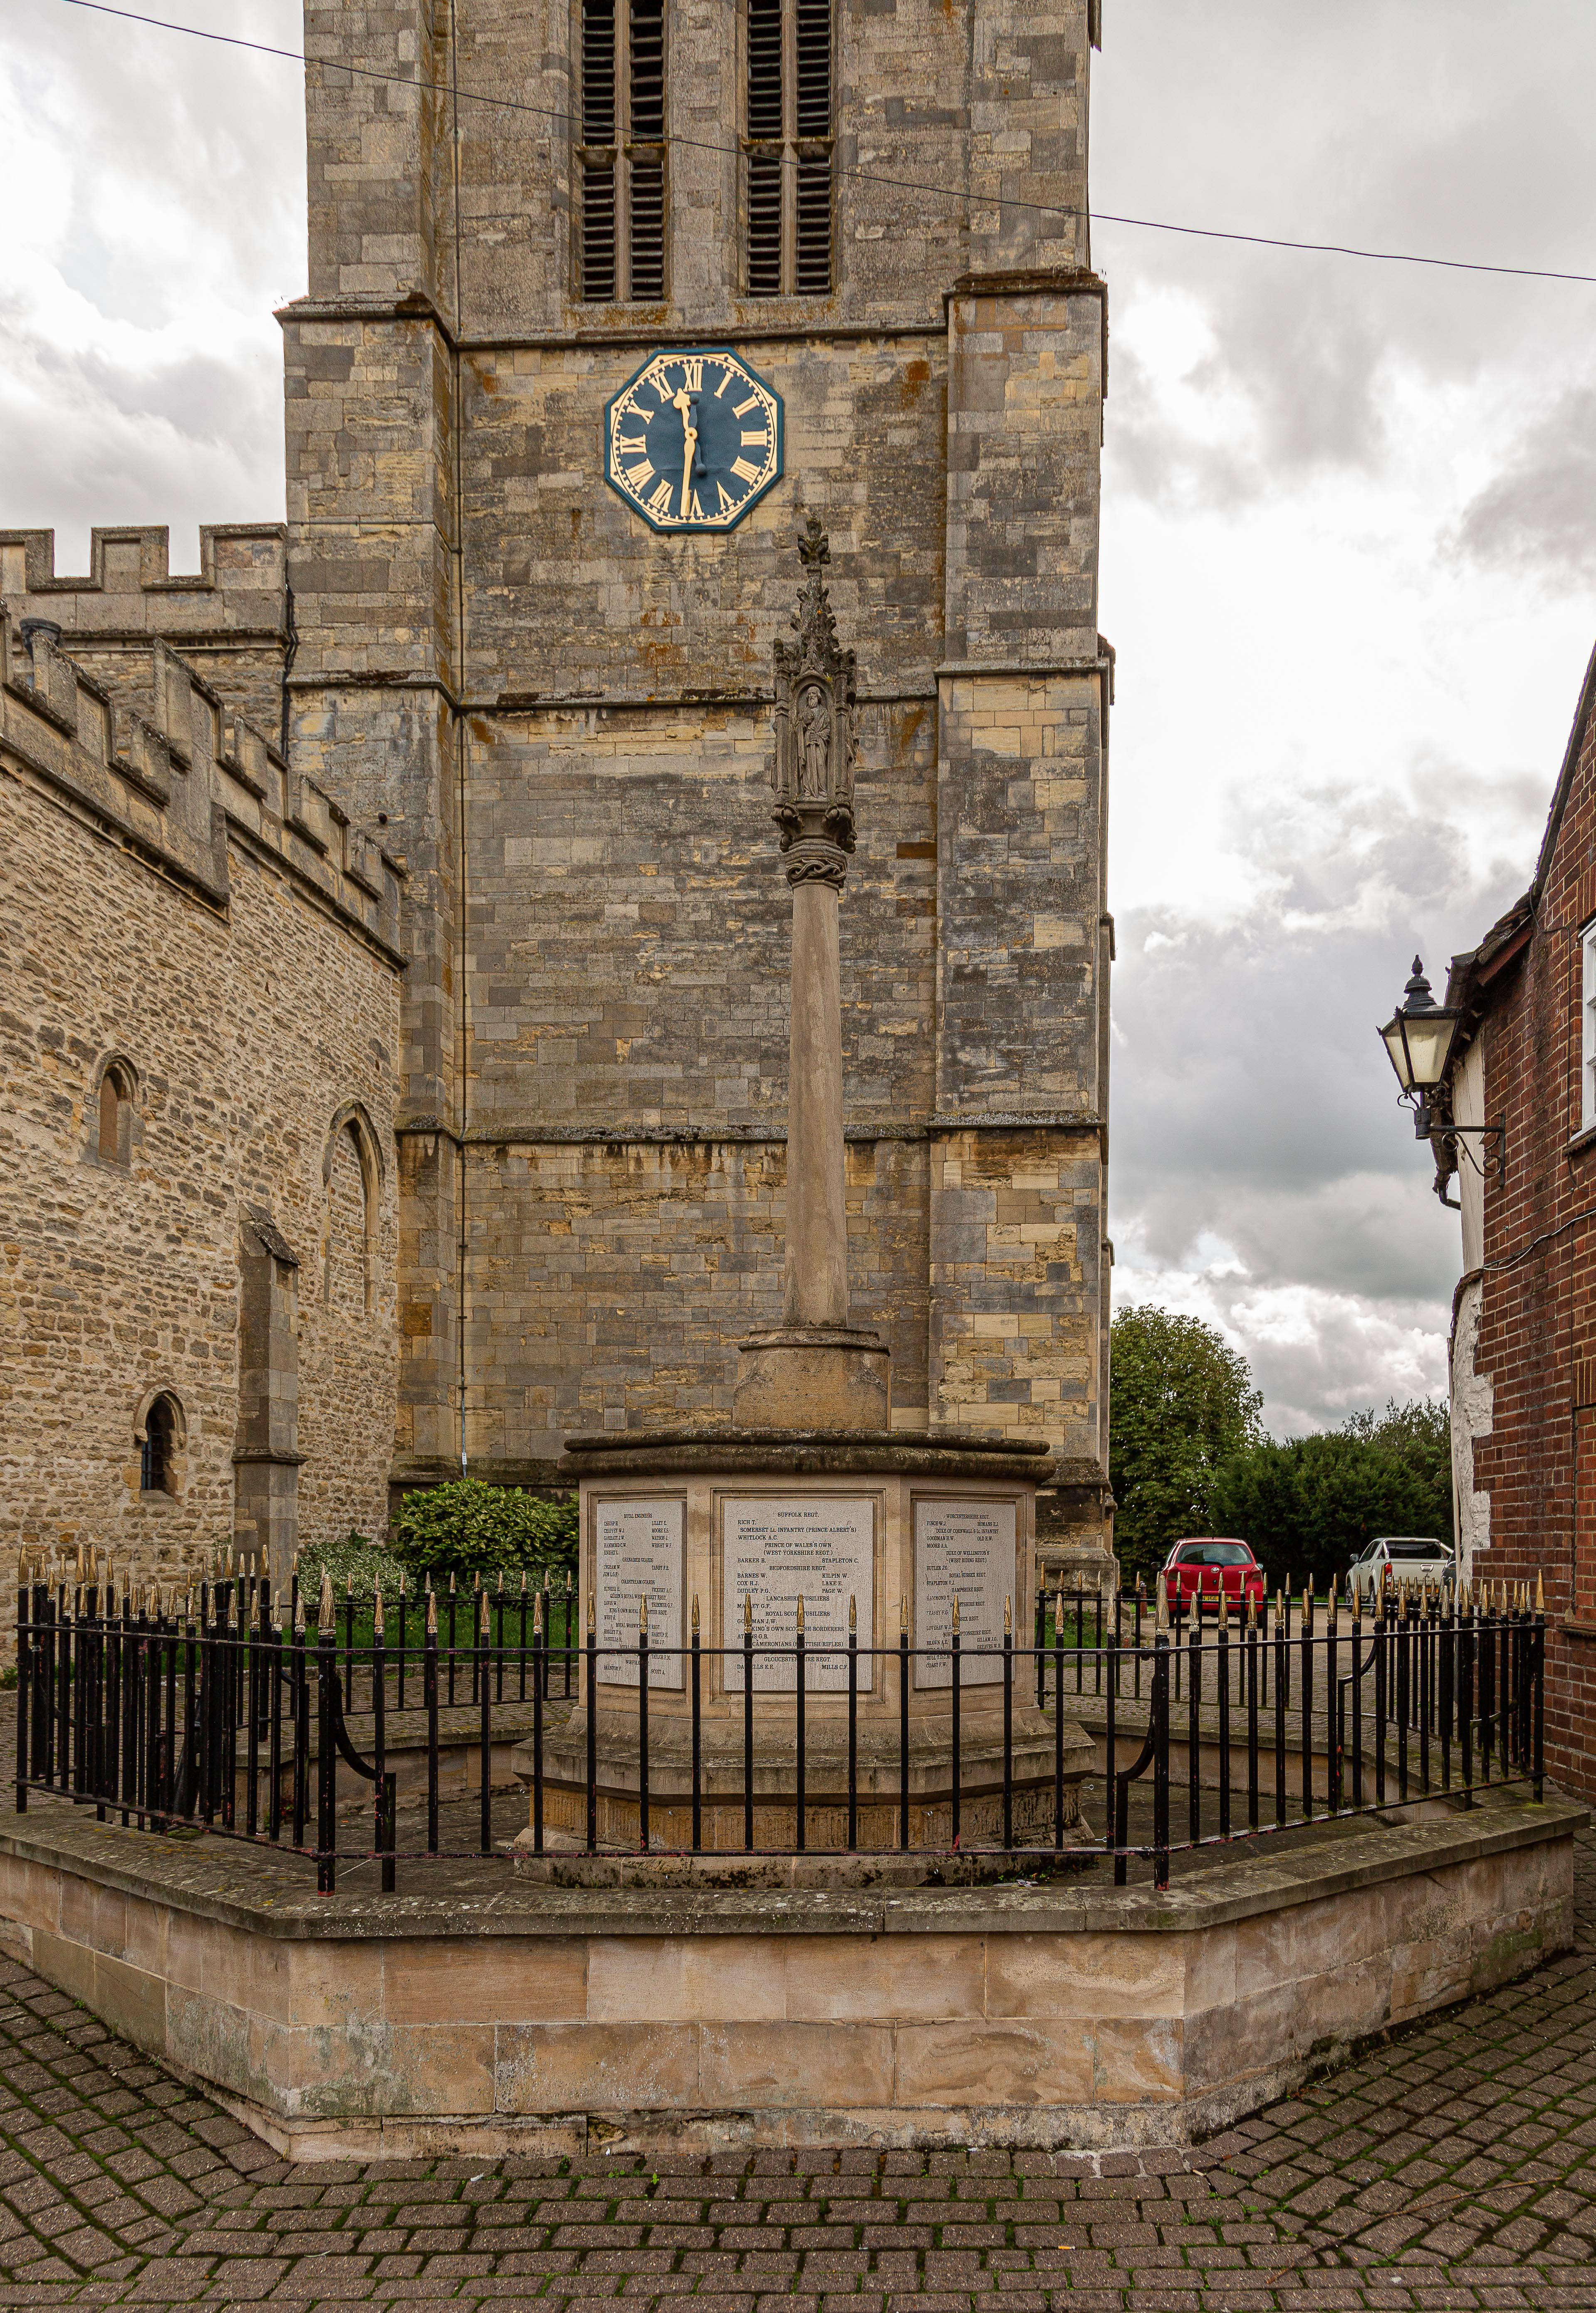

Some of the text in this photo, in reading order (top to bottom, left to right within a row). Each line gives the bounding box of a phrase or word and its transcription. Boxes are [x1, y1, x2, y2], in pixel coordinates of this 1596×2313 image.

[649, 371, 674, 403] XI
[683, 362, 703, 392] XII
[713, 371, 733, 399] I
[626, 399, 654, 424] X
[732, 394, 760, 419] II
[620, 434, 646, 454] IX
[741, 428, 767, 446] III
[625, 458, 656, 493] VIII
[730, 456, 761, 485] IIII
[648, 478, 673, 513] VII
[716, 480, 734, 510] V
